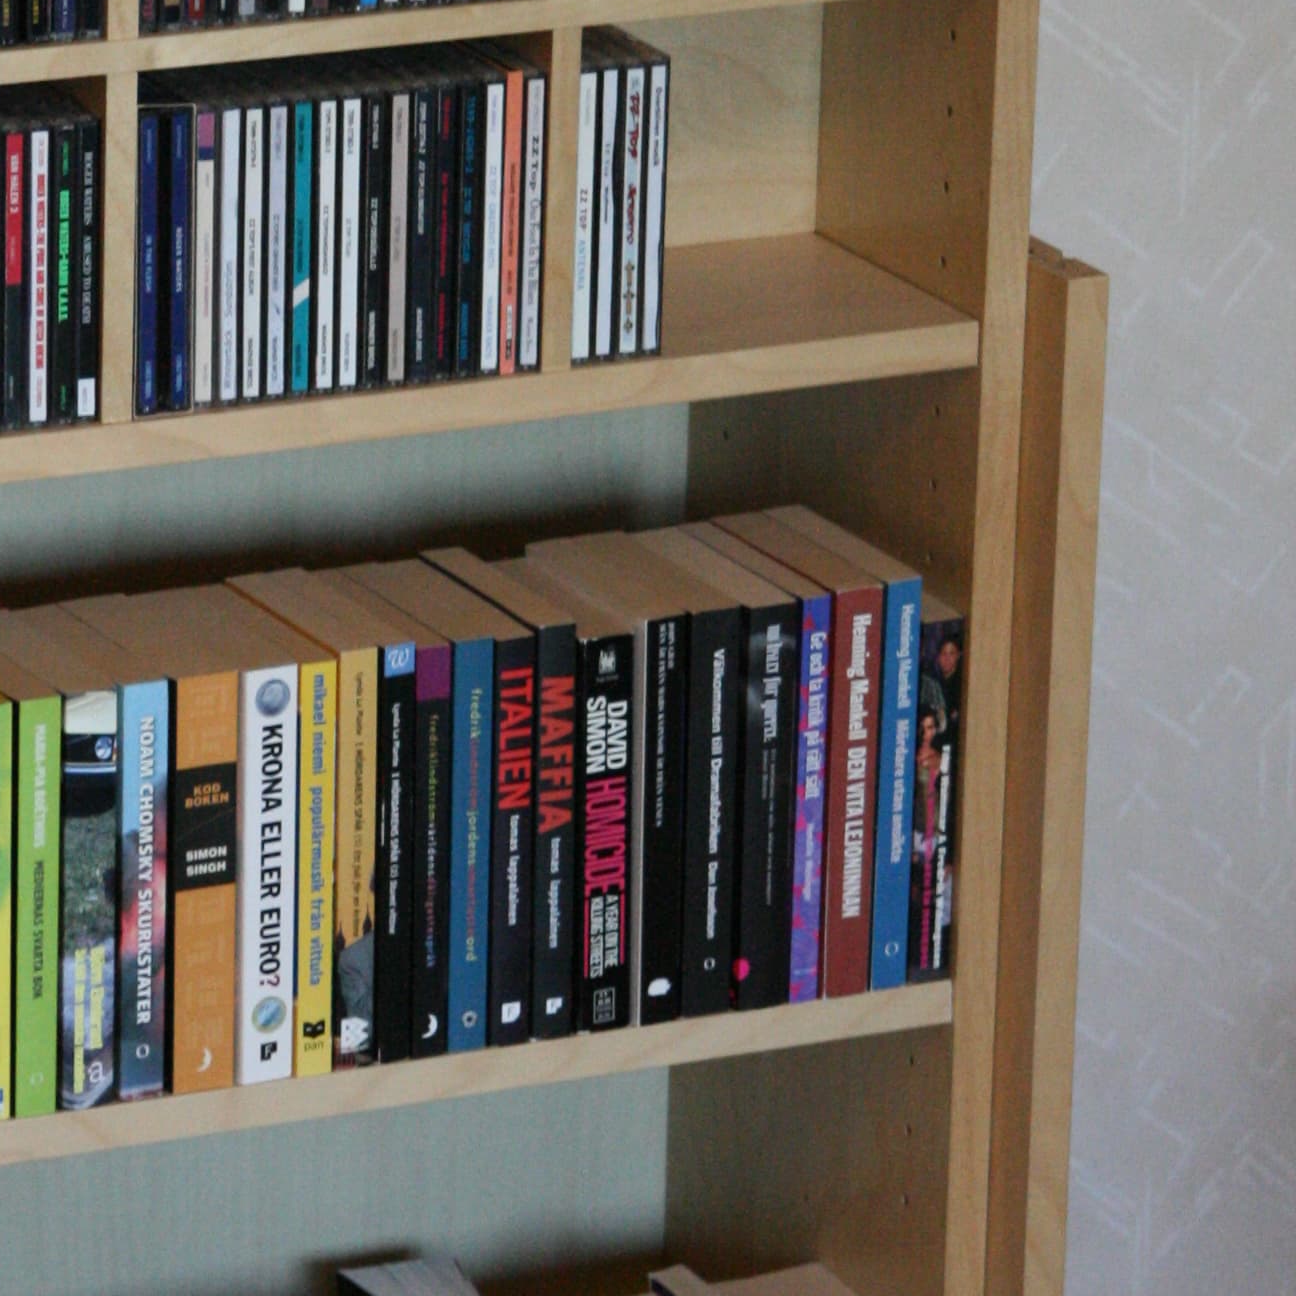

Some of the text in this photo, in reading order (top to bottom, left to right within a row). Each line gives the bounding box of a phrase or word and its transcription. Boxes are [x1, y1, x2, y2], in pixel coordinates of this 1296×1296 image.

[9, 155, 20, 176] VAN
[9, 178, 19, 204] HALEN
[82, 152, 93, 324] ROGER WATERS AMUSED TO DEATH
[499, 665, 532, 809] ITALIEN
[538, 675, 574, 833] MAFFIA
[585, 696, 606, 774] SIMON
[606, 700, 628, 769] DAVID
[708, 649, 726, 854] Välkommen till Dramafabriken
[841, 613, 872, 919] Henning Mankell DEN VITA LEJONINNAN
[135, 716, 155, 1024] NOAM CHOMSKY SKURKSTATER
[186, 847, 227, 860] SIMON
[186, 862, 226, 876] SINGH
[260, 724, 283, 986] KRONA ELLER EURO?
[308, 674, 327, 986] mikael niemi populärmusik från vittula
[584, 775, 626, 897] HOMICIDE
